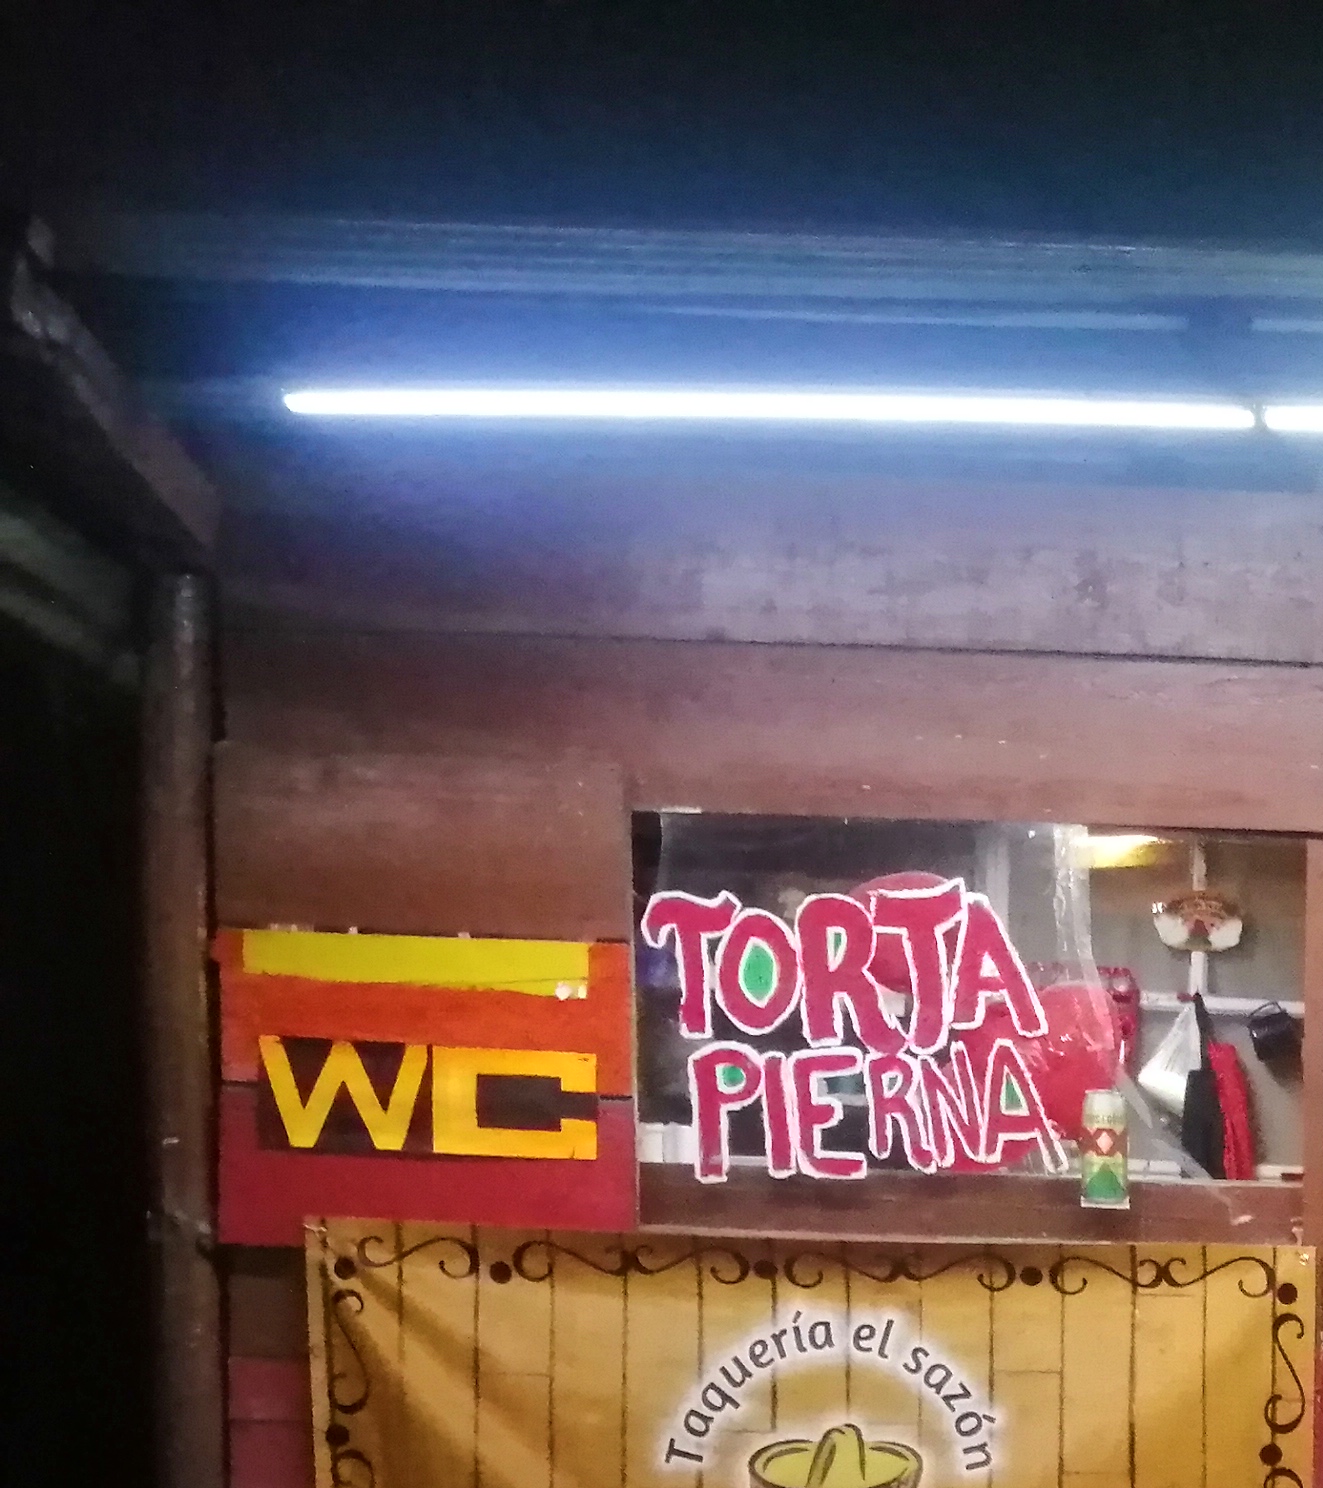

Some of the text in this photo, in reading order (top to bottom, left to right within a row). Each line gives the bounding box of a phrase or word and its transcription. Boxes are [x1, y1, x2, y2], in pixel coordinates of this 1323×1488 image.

[642, 877, 1049, 1056] TORTA
[259, 1034, 598, 1161] WC
[689, 1037, 1068, 1182] PIERNA
[665, 1311, 994, 1471] Taquería el sazón
